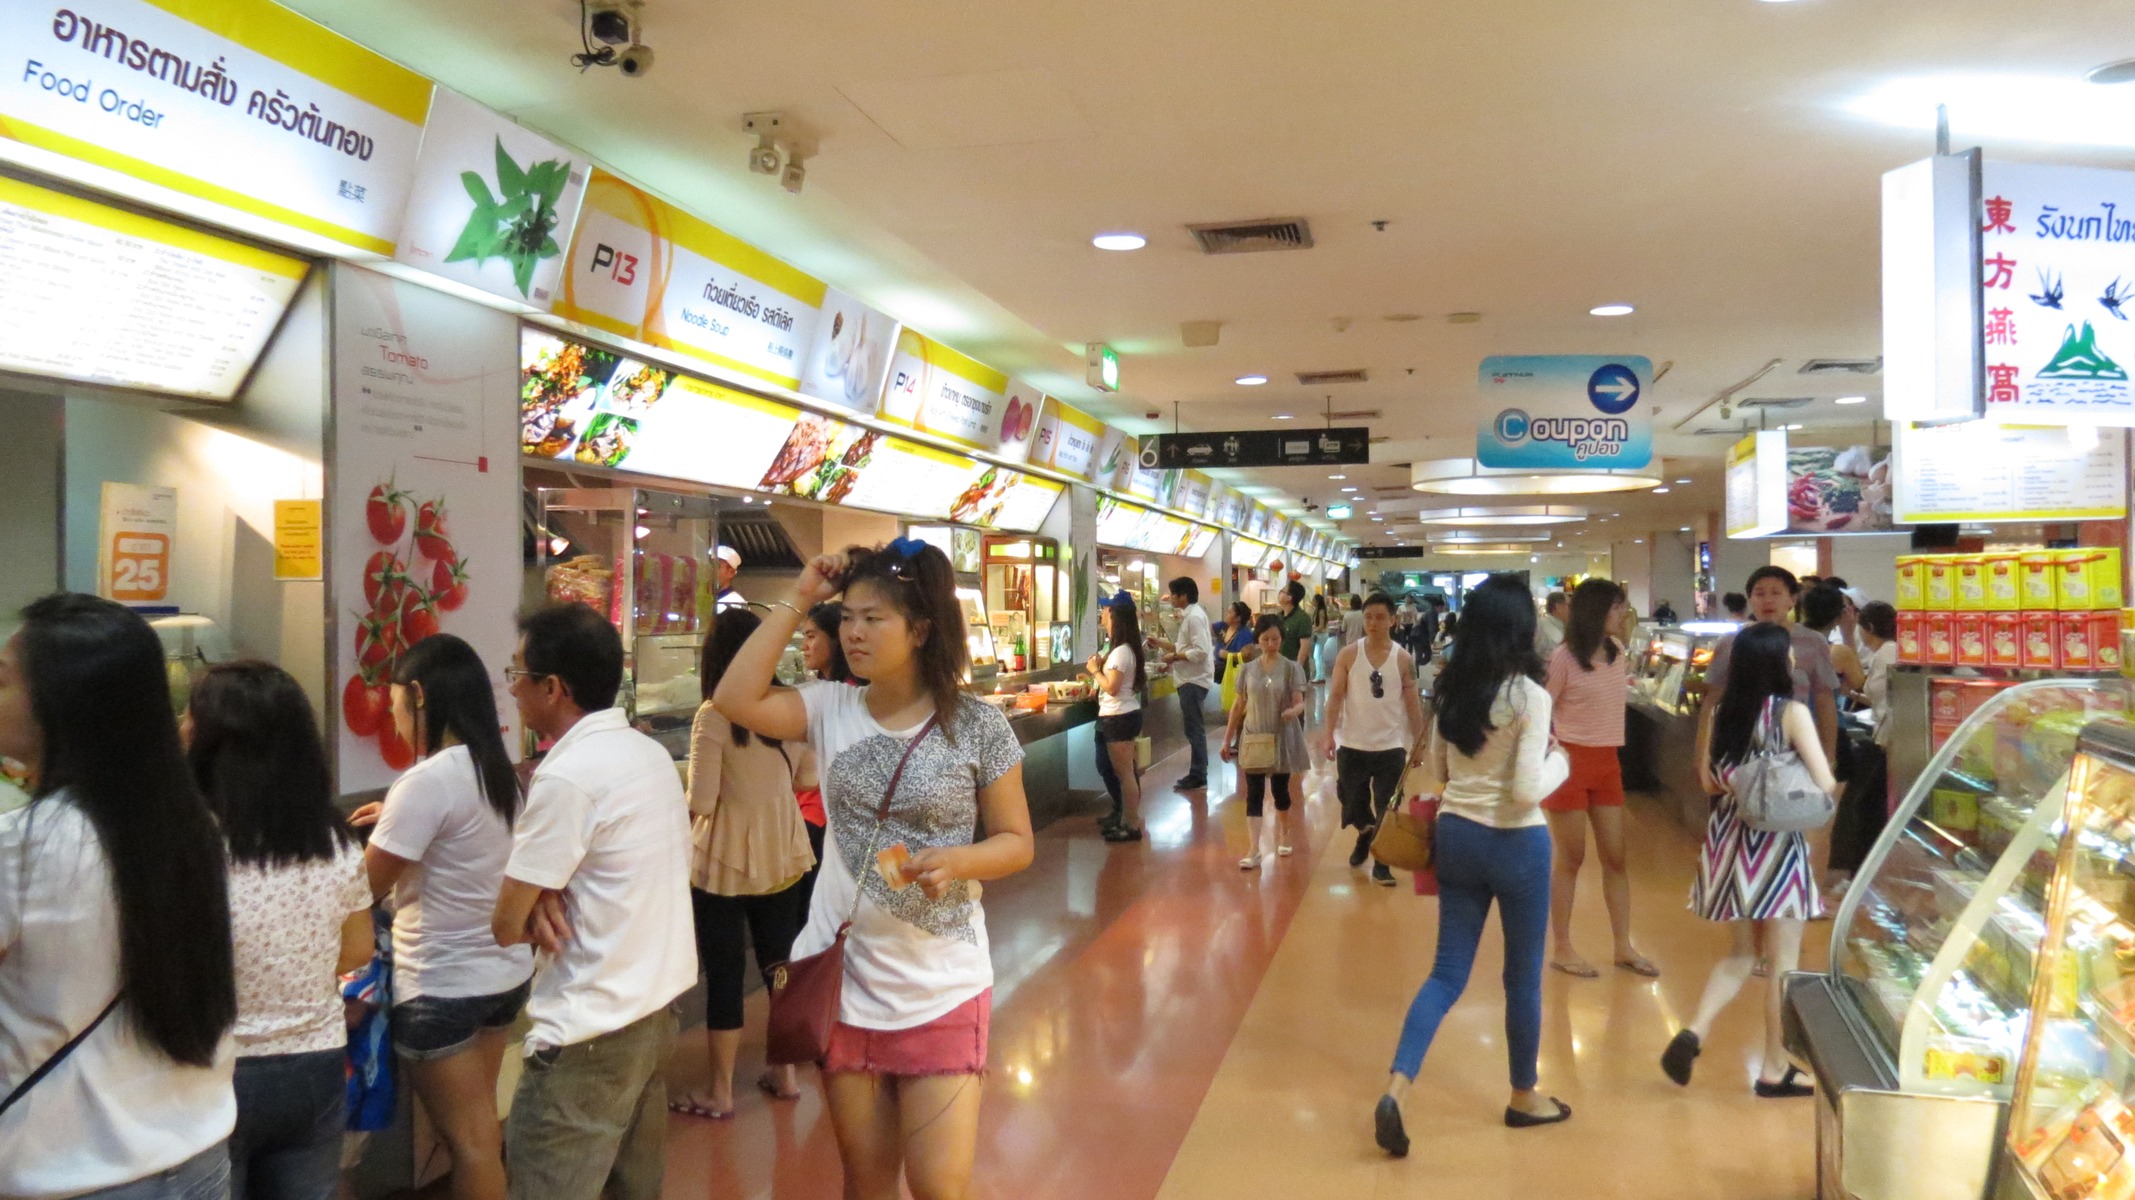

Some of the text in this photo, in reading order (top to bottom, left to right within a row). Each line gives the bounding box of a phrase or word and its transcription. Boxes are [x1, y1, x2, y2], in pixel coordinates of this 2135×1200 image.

[23, 59, 165, 129] Food Order
[52, 8, 375, 162] อาหารตามสั่ง ครัวต้นทอง
[2036, 202, 2135, 243] รังนกไท
[590, 242, 639, 287] P13
[1982, 195, 2019, 403] 東方燕窩
[680, 307, 730, 337] Noodle Soup
[379, 344, 429, 370] Tomato
[894, 371, 917, 396] P14
[1499, 412, 1628, 448] Coupon
[1140, 438, 1158, 468] 6
[1575, 440, 1621, 461] คูปอง
[115, 558, 161, 591] 25
